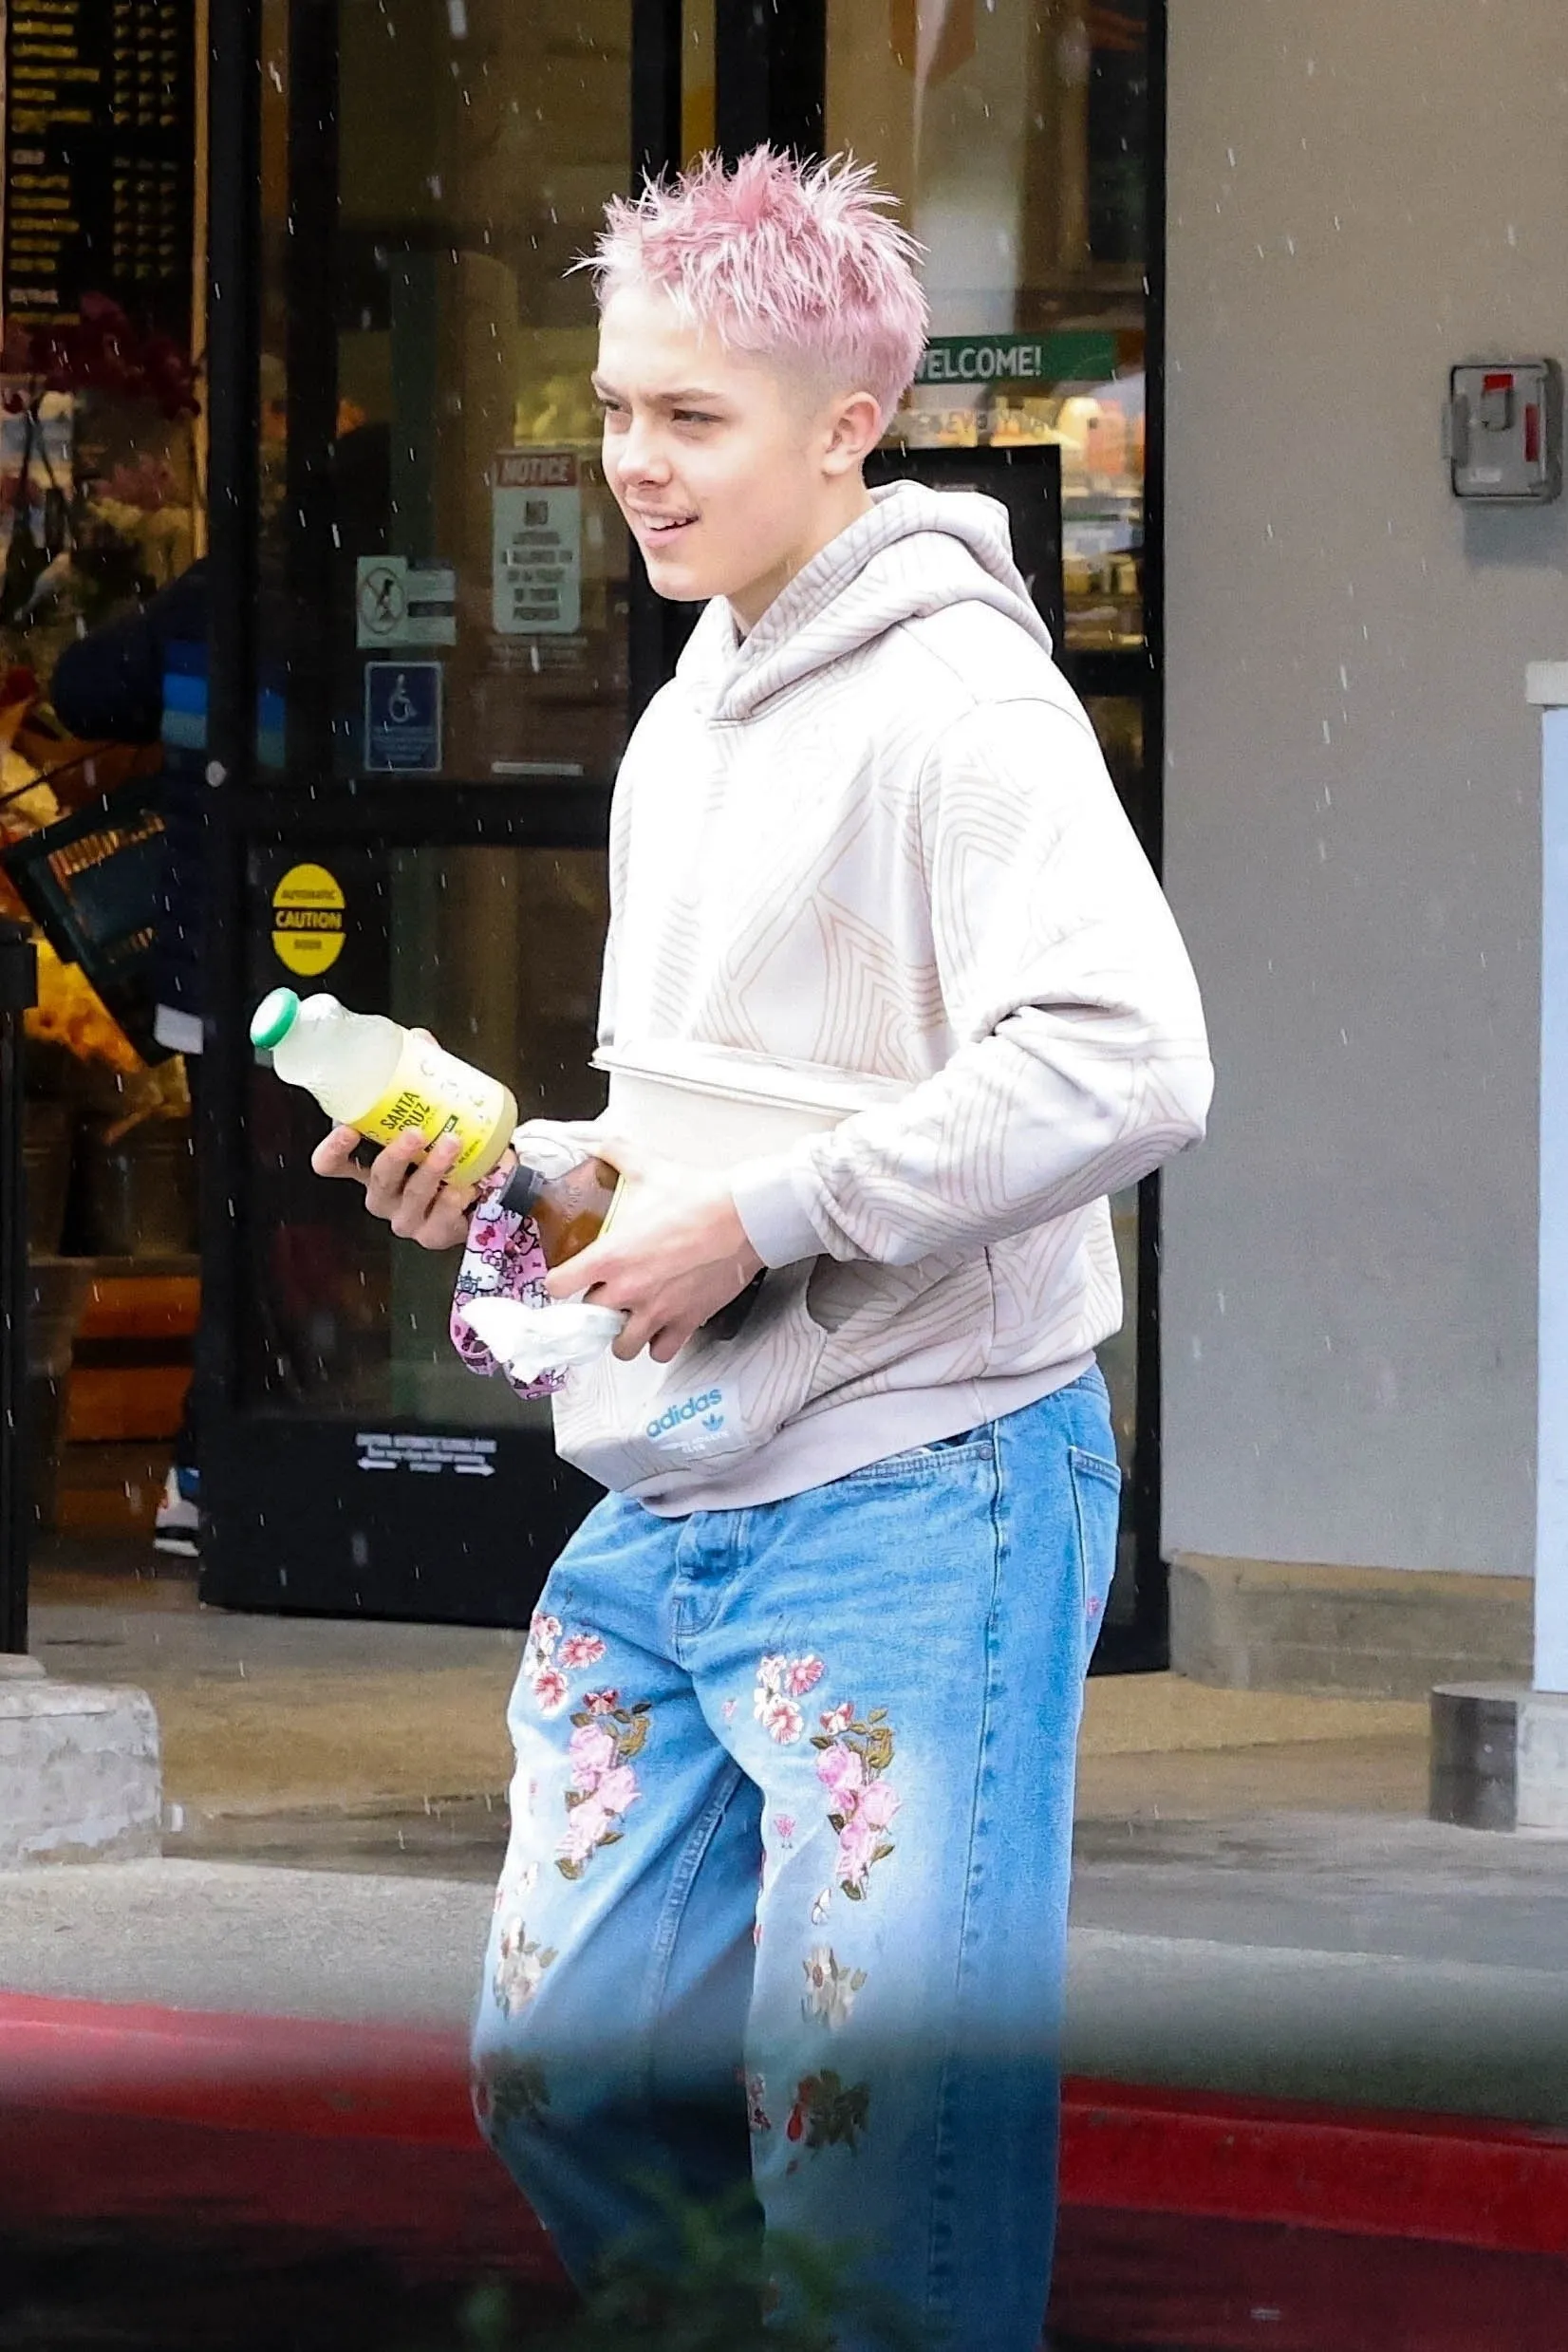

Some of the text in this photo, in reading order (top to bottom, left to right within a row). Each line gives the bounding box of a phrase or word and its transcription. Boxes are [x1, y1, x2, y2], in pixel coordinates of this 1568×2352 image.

[501, 457, 570, 483] NOTICE
[276, 911, 343, 929] CAUTION
[380, 1092, 420, 1130] SANTA
[646, 1389, 722, 1438] adidas
